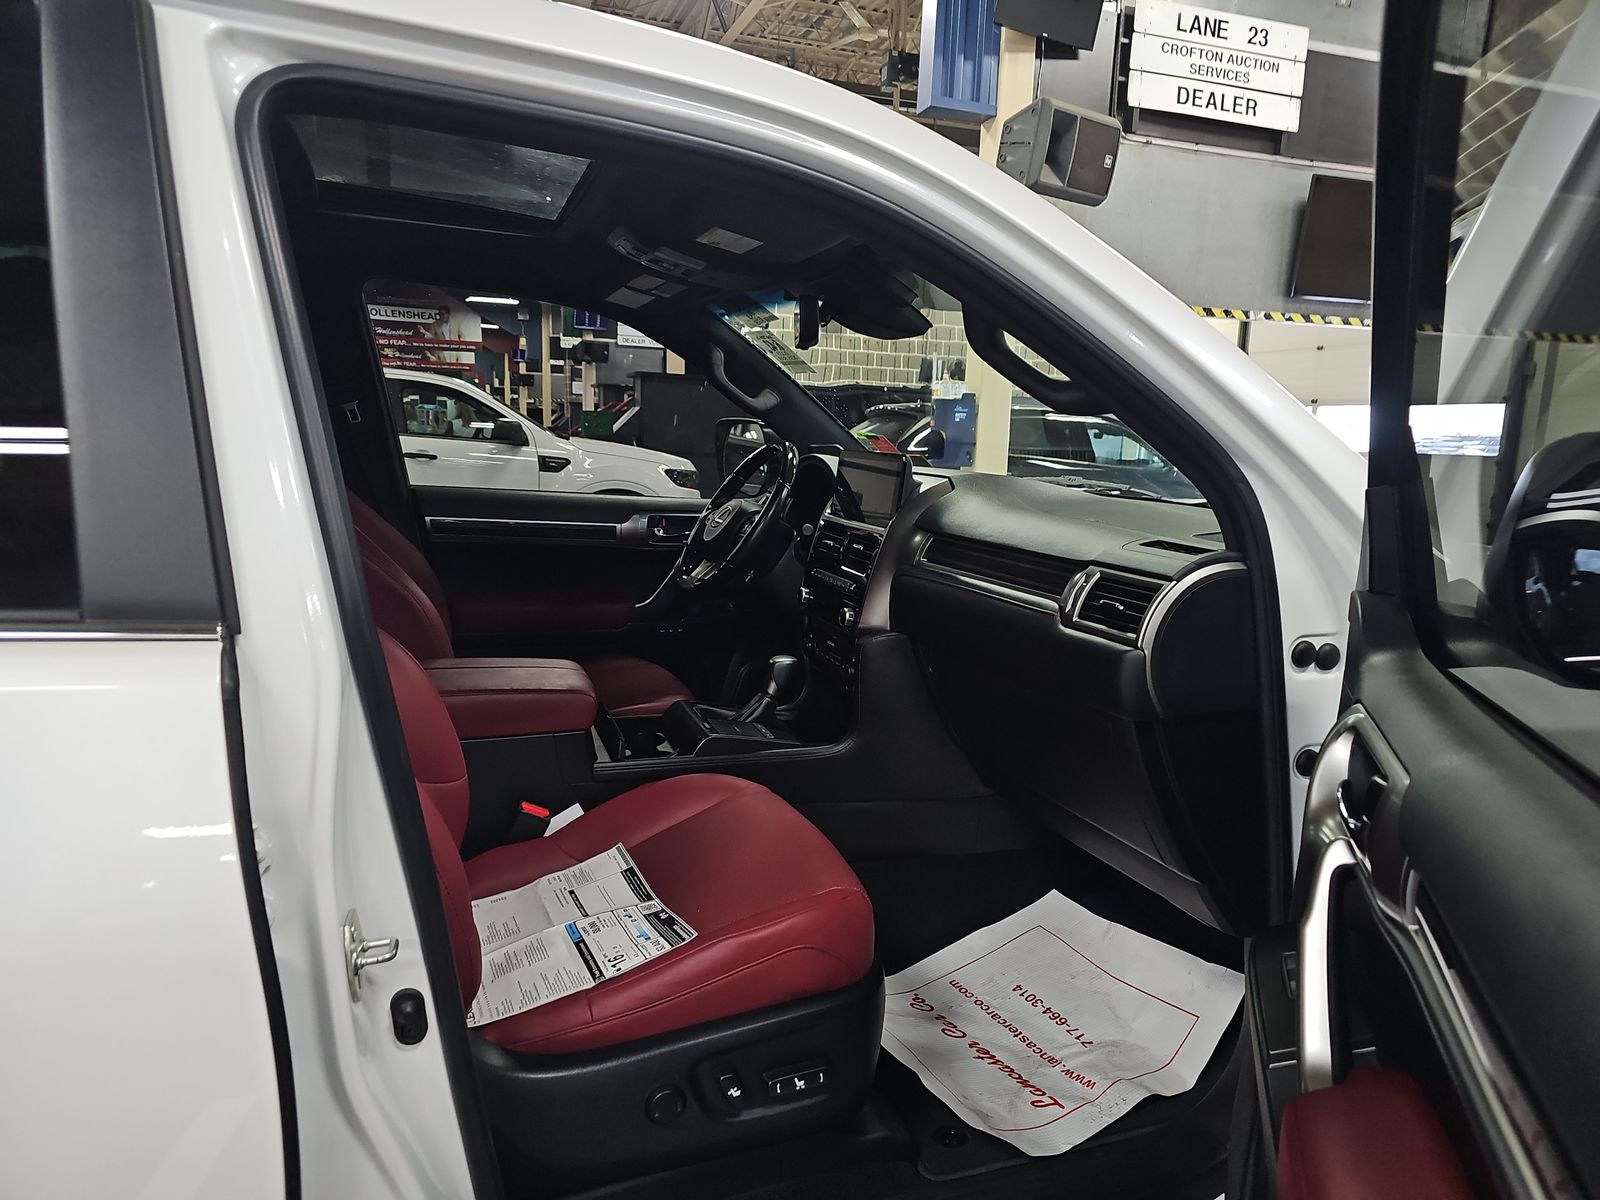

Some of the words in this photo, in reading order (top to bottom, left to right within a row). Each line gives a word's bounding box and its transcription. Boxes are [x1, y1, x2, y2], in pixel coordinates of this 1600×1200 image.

[1177, 12, 1229, 40] LANE
[1247, 26, 1269, 47] 23
[1161, 42, 1223, 63] CROFTON
[1226, 53, 1280, 74] AUCTION
[1189, 63, 1250, 83] SERVICES
[1177, 86, 1257, 117] DEALER
[908, 992, 935, 1012] Co.
[1011, 983, 1094, 1049] 717-664-3014
[934, 1013, 968, 1040] Car
[948, 979, 1096, 1090] www.lancastercarco.com
[968, 1040, 1065, 1110] Lancaster
